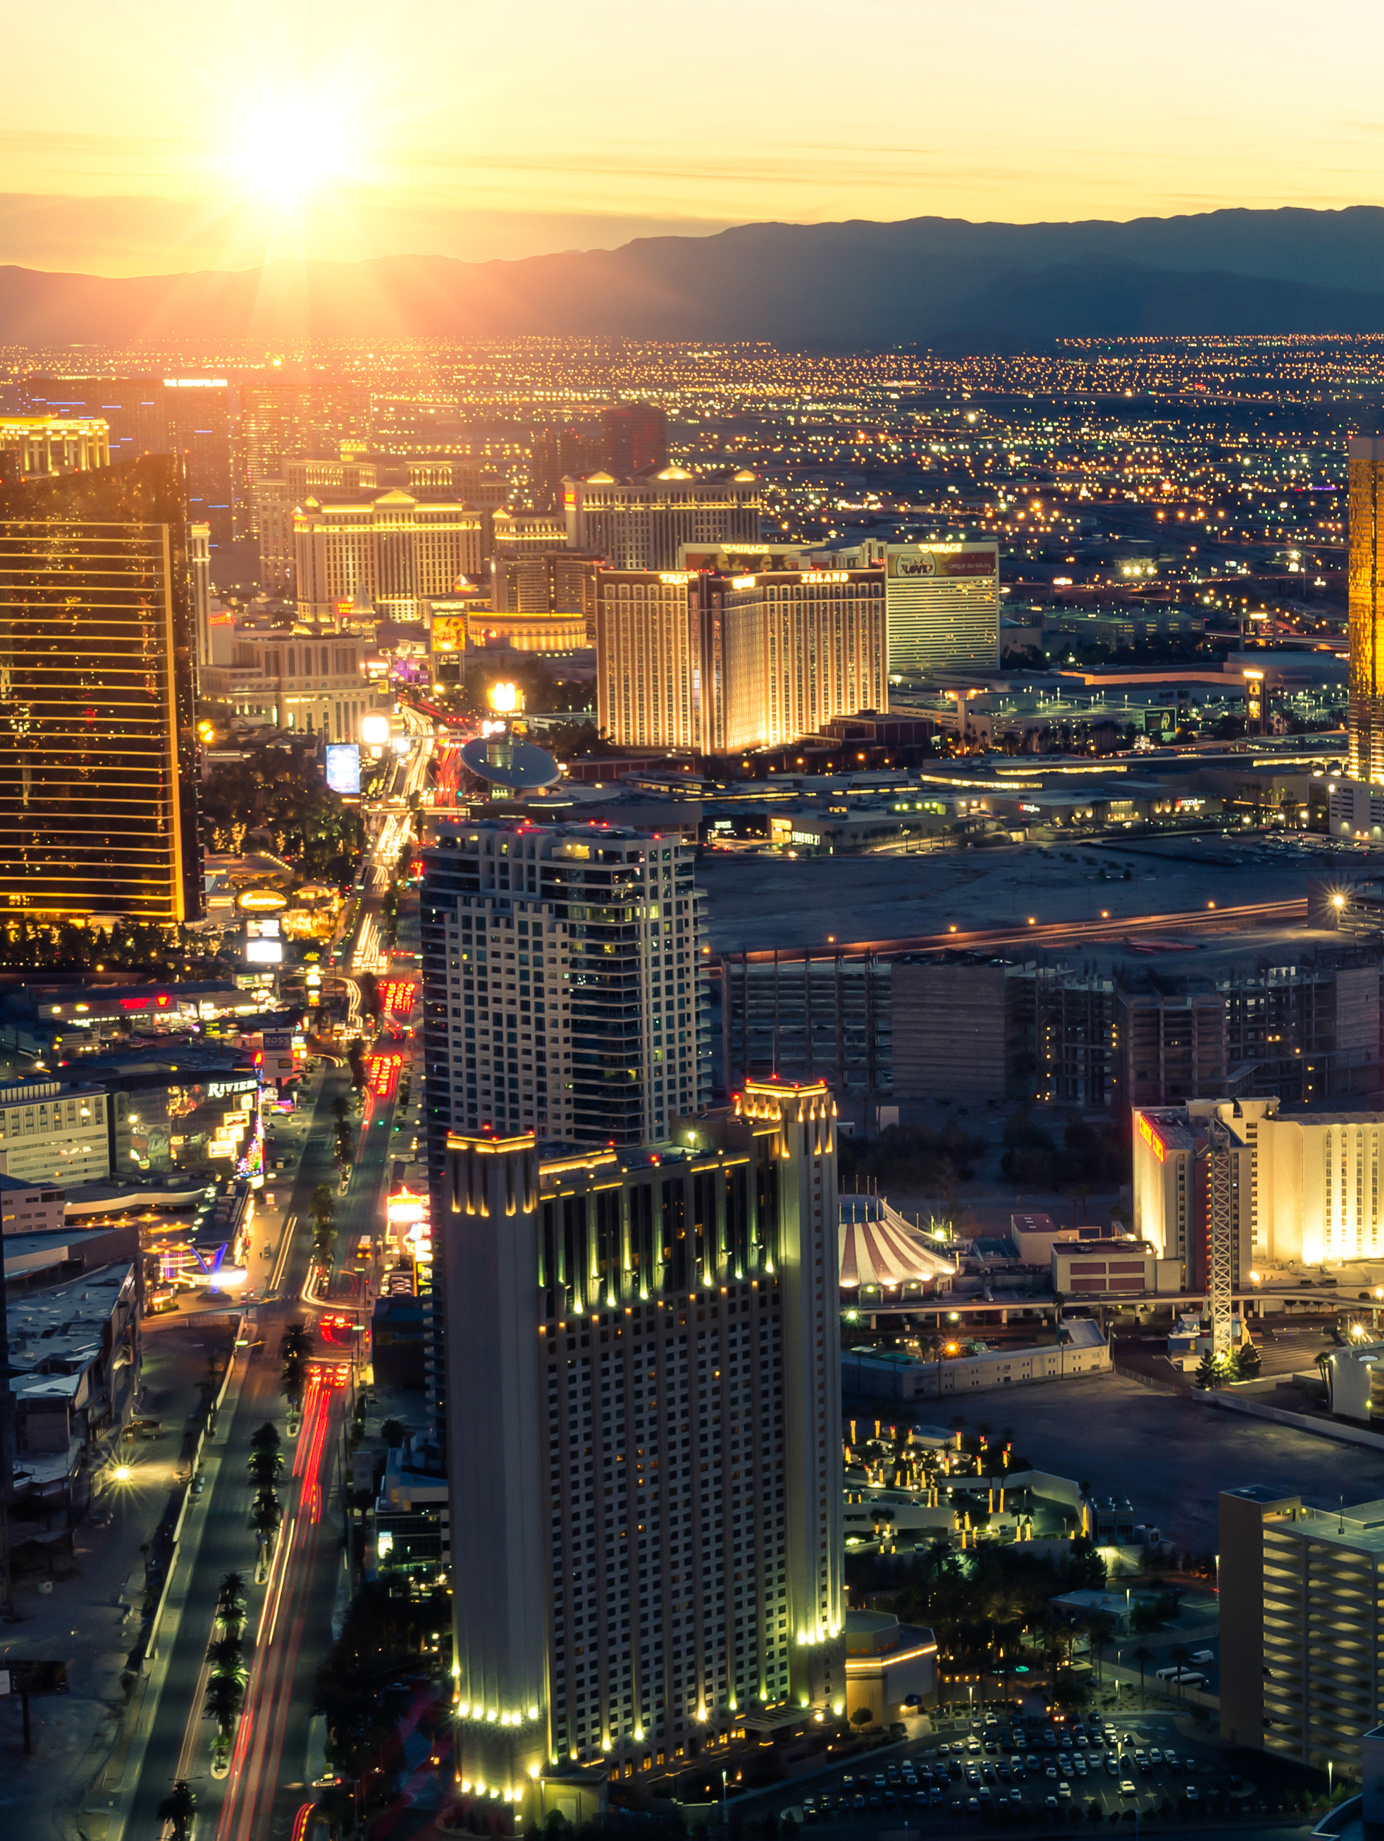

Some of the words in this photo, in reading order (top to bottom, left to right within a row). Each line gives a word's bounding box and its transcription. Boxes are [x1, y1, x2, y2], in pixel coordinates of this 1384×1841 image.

[723, 544, 769, 554] MIRAGE
[922, 543, 962, 554] MIRAGE
[801, 572, 849, 583] ISLAND
[792, 831, 814, 844] FOREVER
[265, 1036, 290, 1044] ROSS
